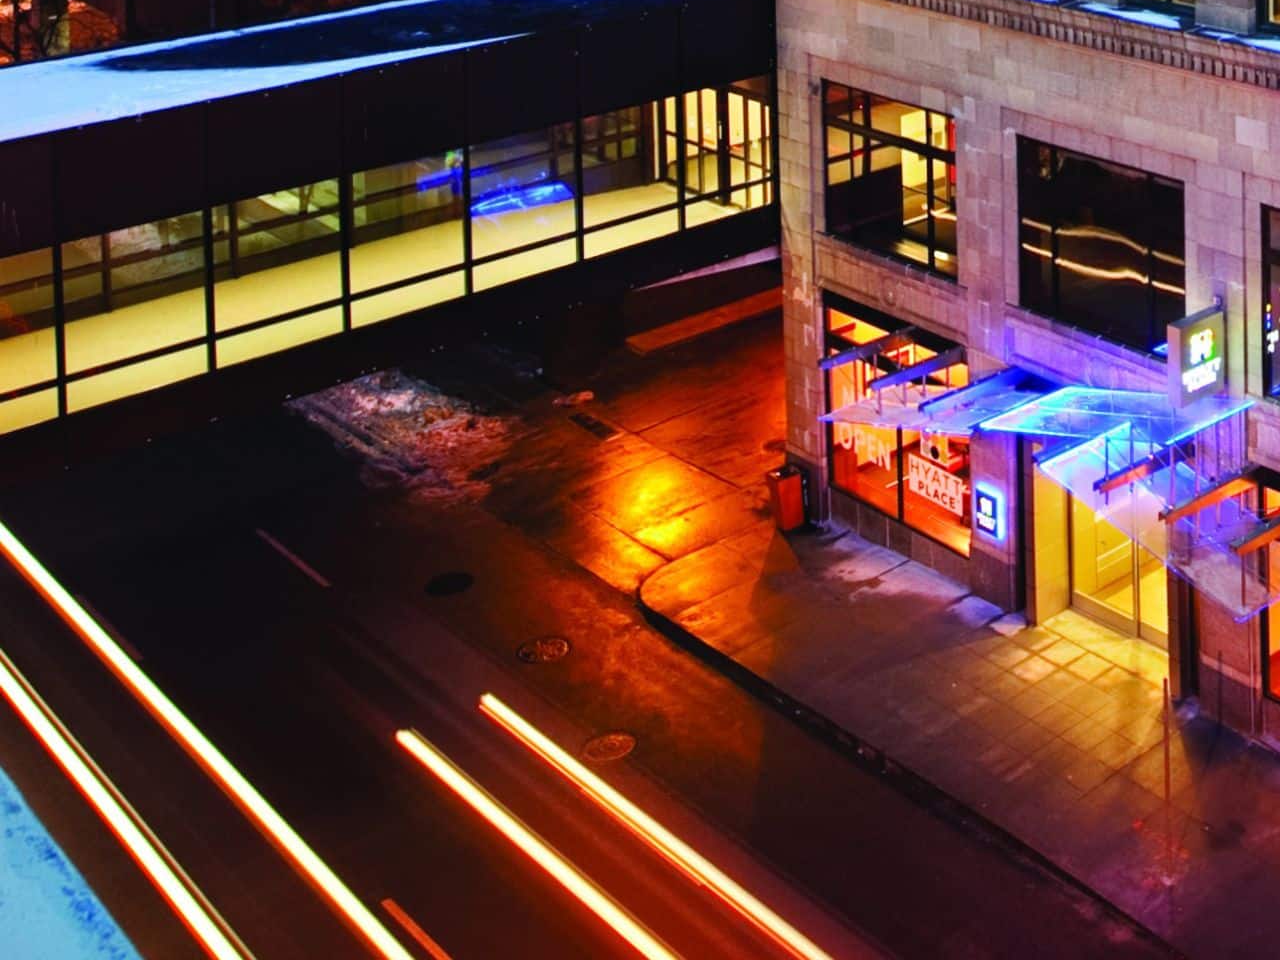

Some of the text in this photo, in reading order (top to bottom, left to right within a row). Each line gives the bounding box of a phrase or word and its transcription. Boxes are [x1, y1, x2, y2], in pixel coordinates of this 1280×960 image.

[839, 422, 891, 471] OPEN
[910, 459, 961, 493] HYATT
[918, 479, 956, 510] PLACE
